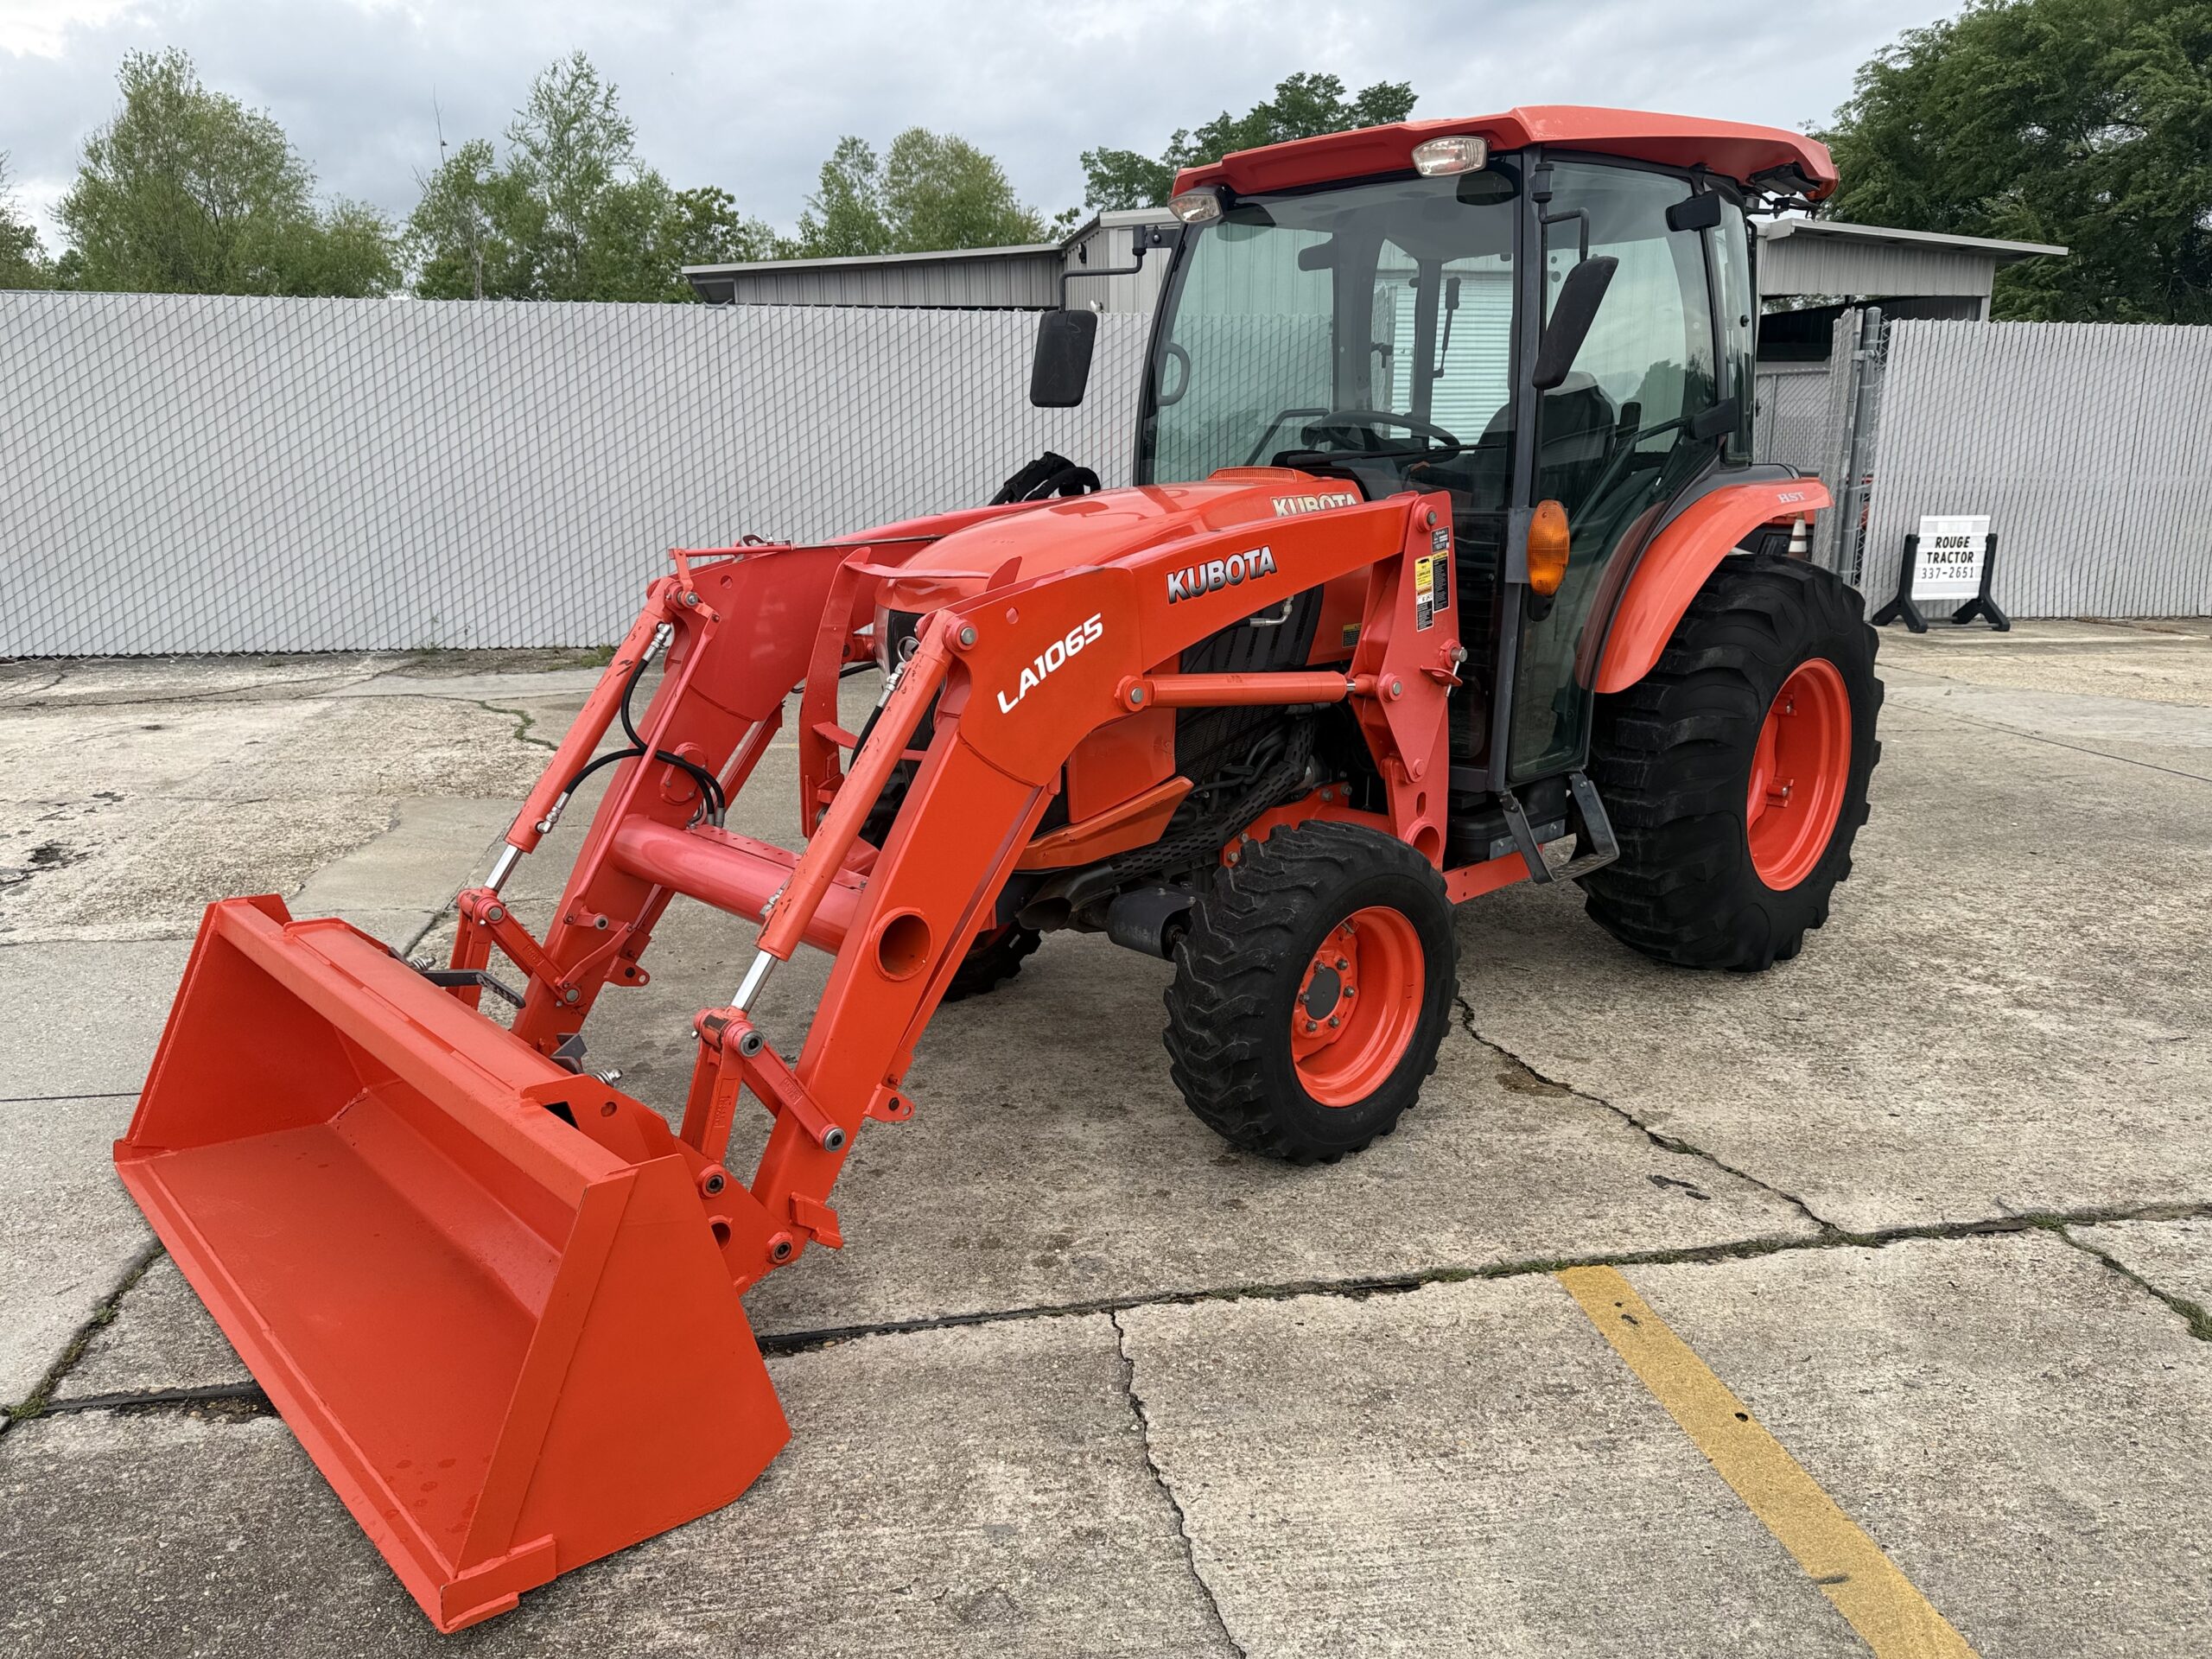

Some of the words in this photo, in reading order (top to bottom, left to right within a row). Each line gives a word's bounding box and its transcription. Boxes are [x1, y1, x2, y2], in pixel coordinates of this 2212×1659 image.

[1777, 492, 1804, 503] HST
[1936, 536, 1970, 549] ROUGE
[1927, 551, 1974, 564] TRACTOR
[1166, 544, 1277, 604] KUBOTA
[1921, 566, 1974, 579] 337-2651
[996, 612, 1103, 714] LA1065
